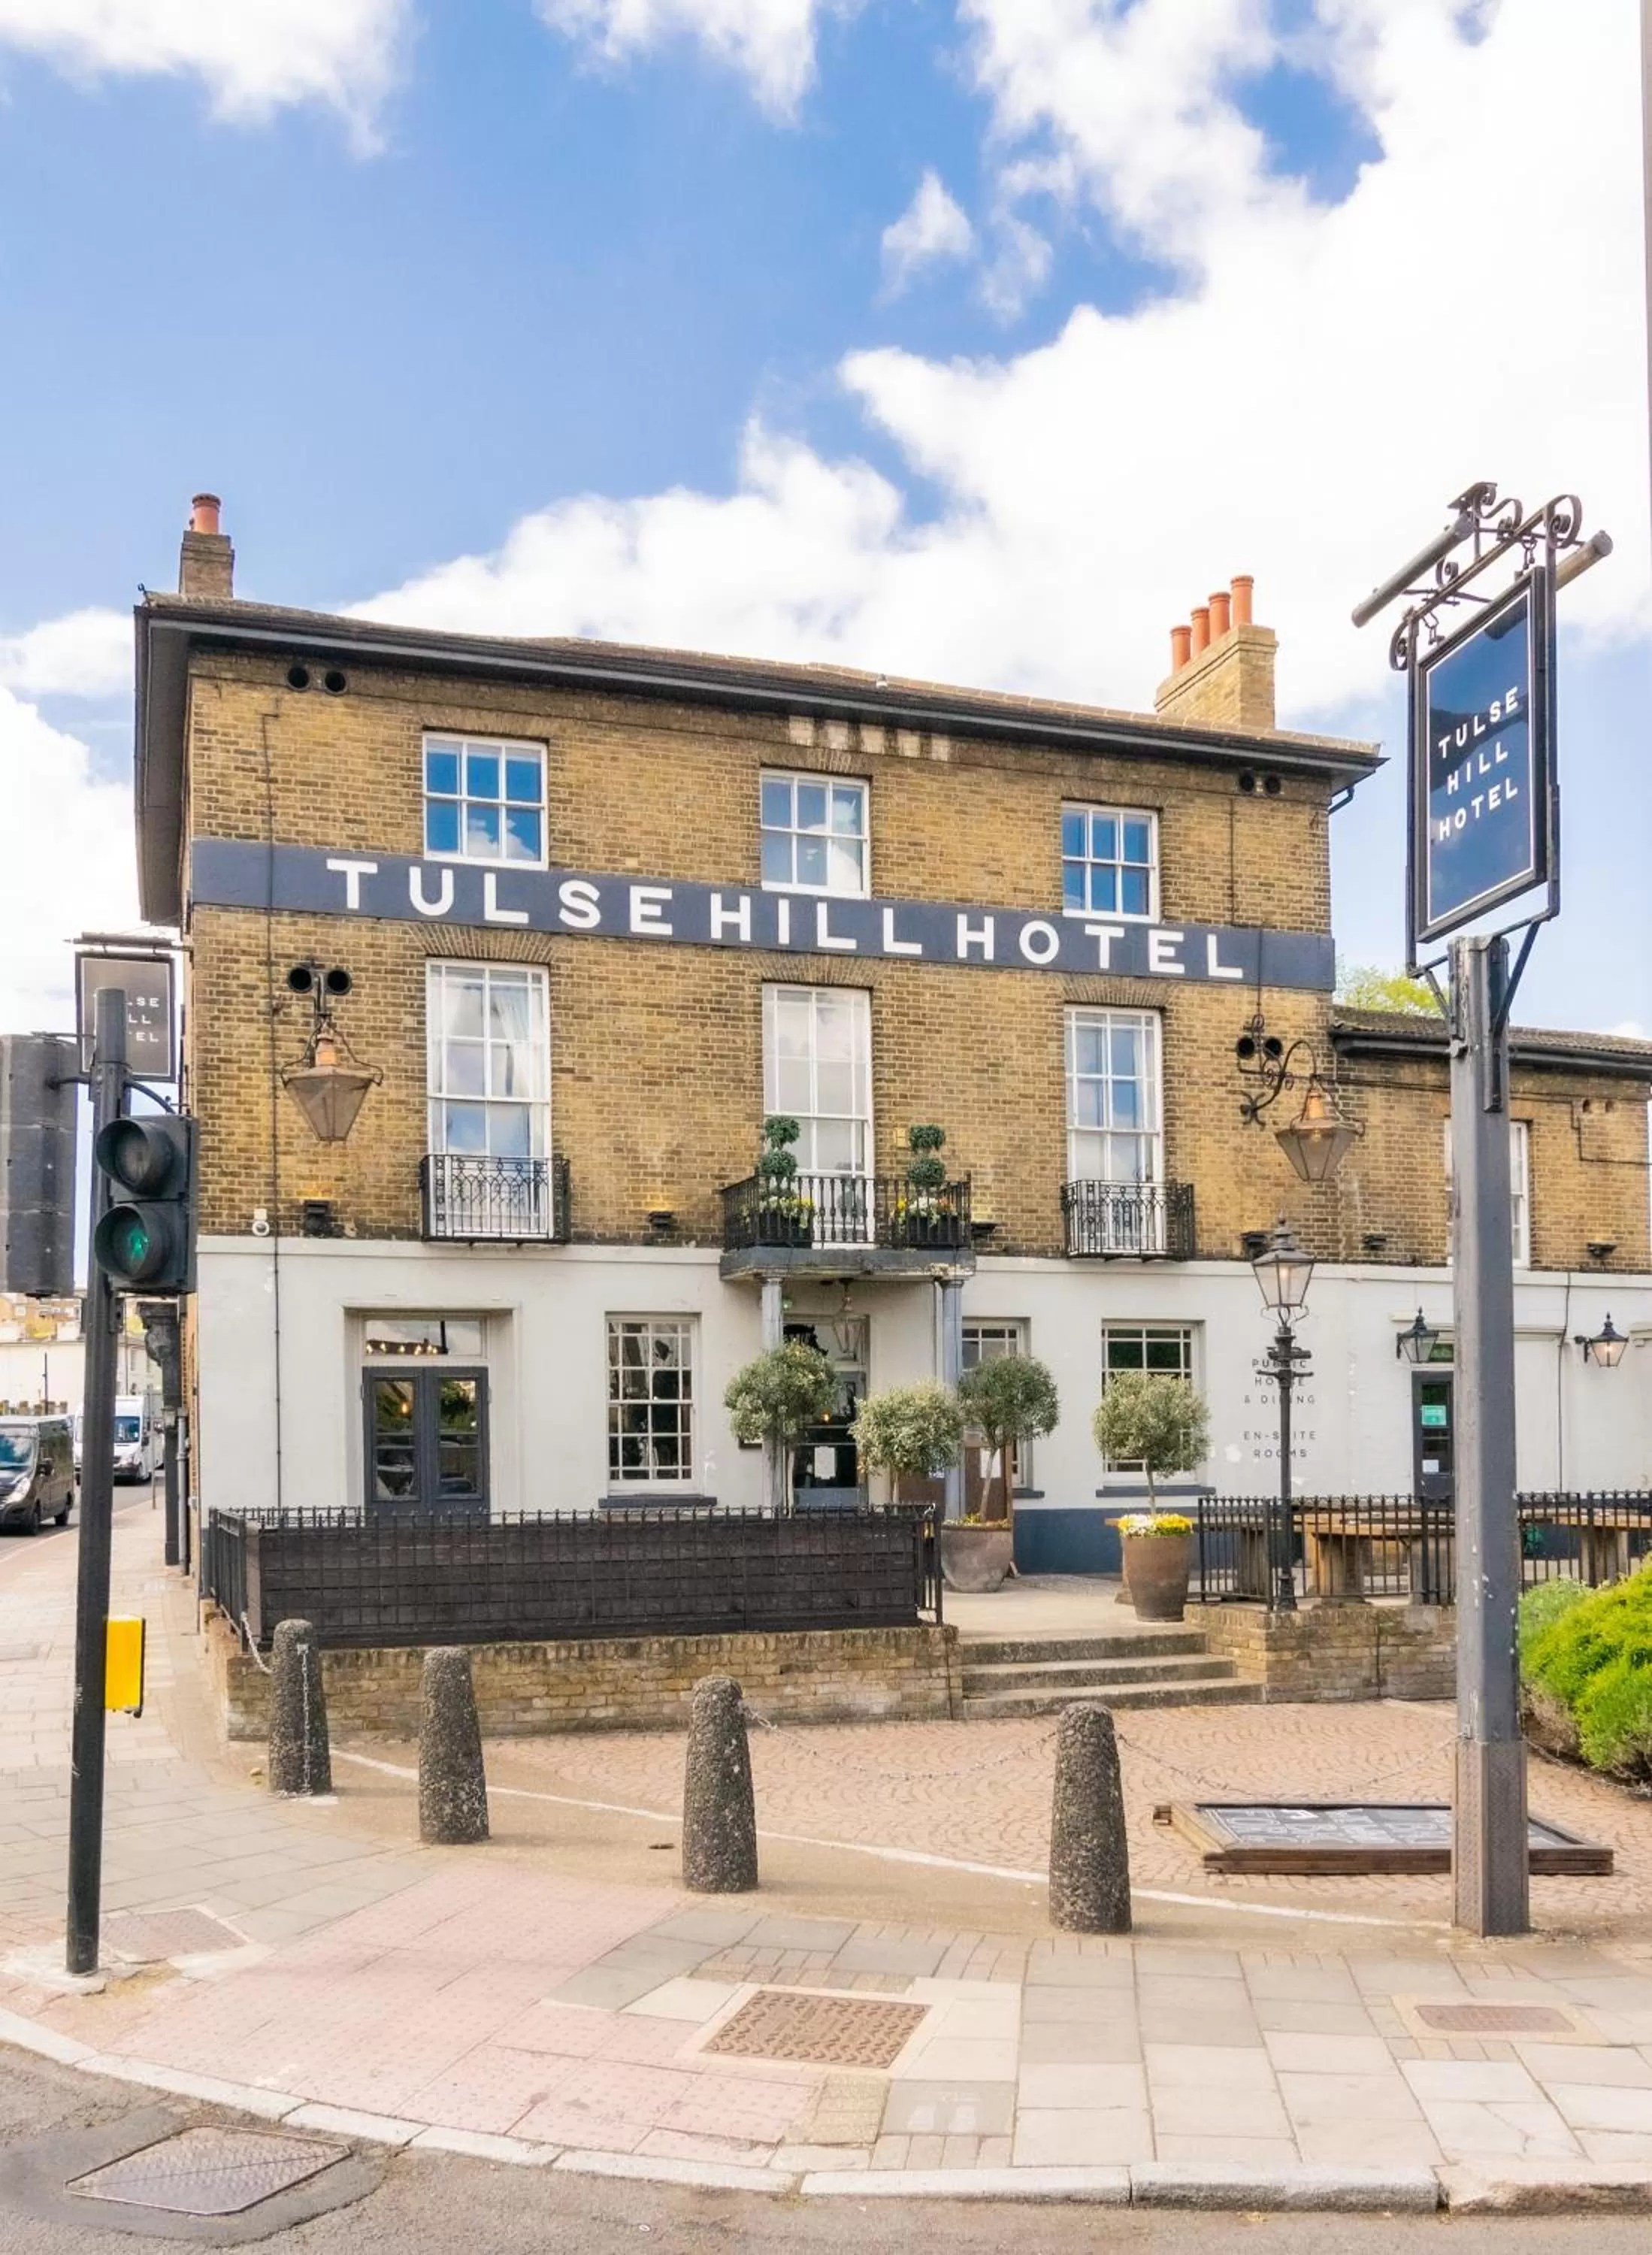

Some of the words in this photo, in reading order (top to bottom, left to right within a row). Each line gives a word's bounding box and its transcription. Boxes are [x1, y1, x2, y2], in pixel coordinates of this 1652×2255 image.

[1438, 686, 1519, 758] TULSE
[1446, 741, 1508, 795] HILL
[1439, 777, 1519, 841] HOTEL
[325, 858, 673, 936] TULSE
[710, 892, 923, 956] HILL
[956, 913, 1244, 979] HOTEL
[1251, 1358, 1307, 1369] PUBIC
[1254, 1376, 1305, 1387] HOE
[1260, 1394, 1315, 1405] DING
[1244, 1430, 1317, 1441] EN-SITE
